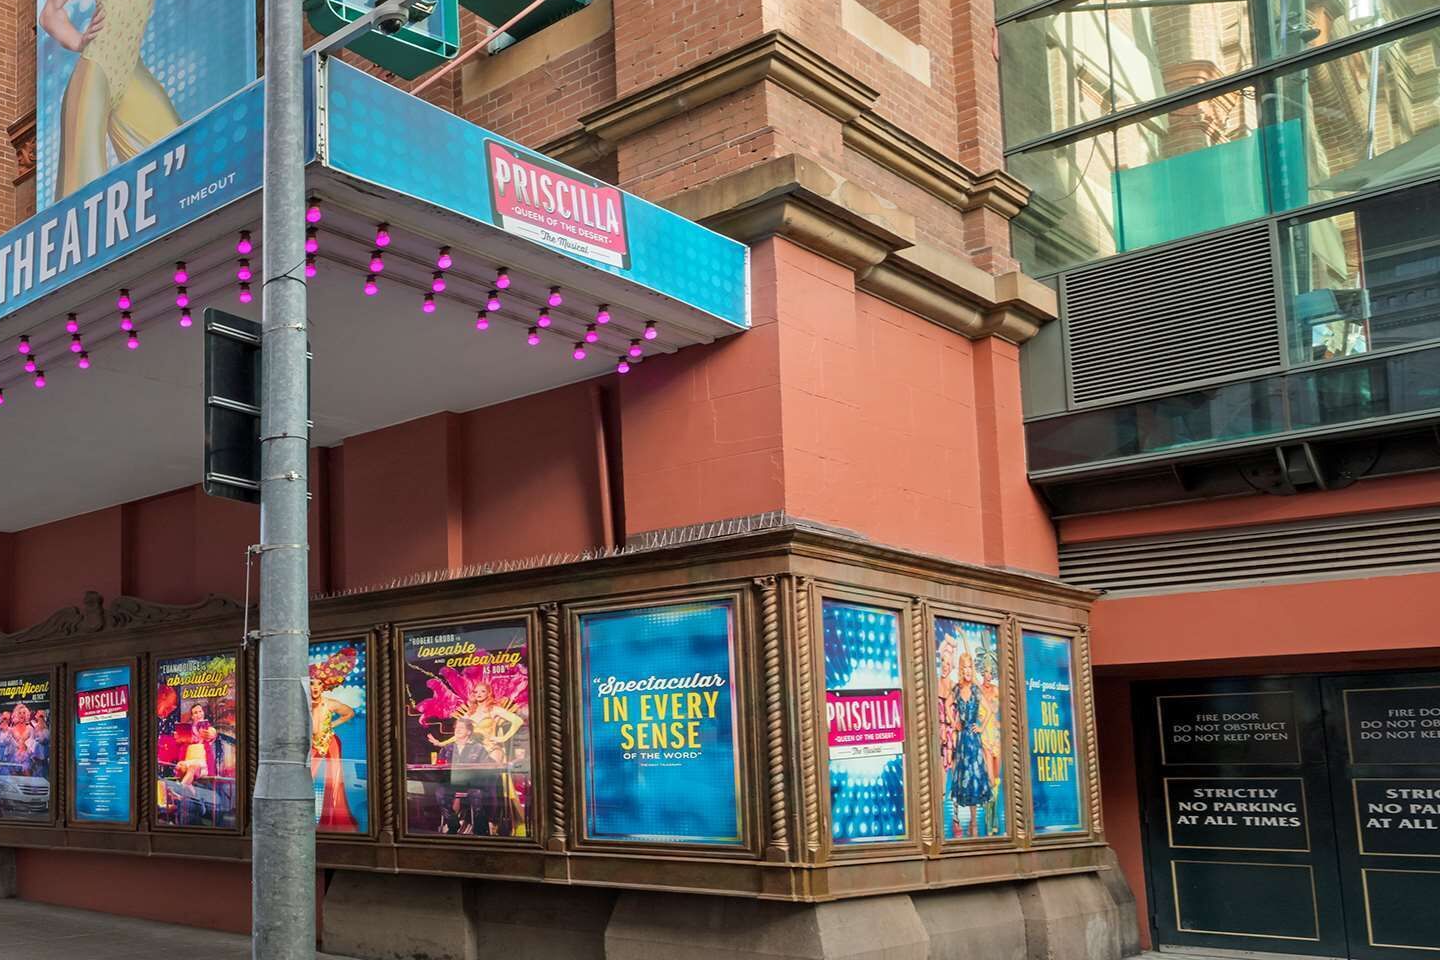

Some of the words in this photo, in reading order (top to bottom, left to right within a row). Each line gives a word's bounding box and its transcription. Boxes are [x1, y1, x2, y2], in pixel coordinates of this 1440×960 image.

[178, 172, 236, 209] TIMEOUT
[495, 157, 620, 235] PRISCILLA
[514, 207, 545, 223] QUEEN
[546, 217, 558, 227] OF
[560, 221, 577, 234] THE
[578, 227, 609, 244] DESERT
[541, 230, 556, 242] The
[417, 641, 476, 658] loveable
[446, 651, 522, 668] endearing
[483, 665, 491, 674] AS
[167, 671, 223, 686] absolutely
[79, 690, 126, 711] PRISCILLA
[603, 695, 628, 722] IN
[640, 691, 719, 721] EVERY
[826, 700, 901, 732] PRISCILLA
[1041, 701, 1059, 727] BIG
[1196, 714, 1219, 722] FIRE
[1223, 713, 1260, 721] DOOR
[1388, 708, 1416, 717] FIRE
[1195, 724, 1220, 732] NOT
[1223, 722, 1287, 731] OBSTRUCT
[1361, 721, 1382, 729] DO
[1386, 720, 1416, 728] NOT
[620, 721, 702, 750] SENSE
[1033, 728, 1070, 754] JOYOUS
[1195, 734, 1220, 742] NOT
[1361, 731, 1382, 739] DO
[1386, 731, 1416, 739] NOT
[1193, 788, 1278, 798] STRICTLY
[1178, 802, 1207, 811] NO
[1213, 802, 1297, 813] PARKING
[1368, 803, 1402, 814] NO
[1177, 815, 1199, 825] AT
[1204, 816, 1238, 826] ALL
[1242, 816, 1301, 827] TIMES
[1366, 818, 1392, 828] AT
[1398, 819, 1438, 829] ALL
